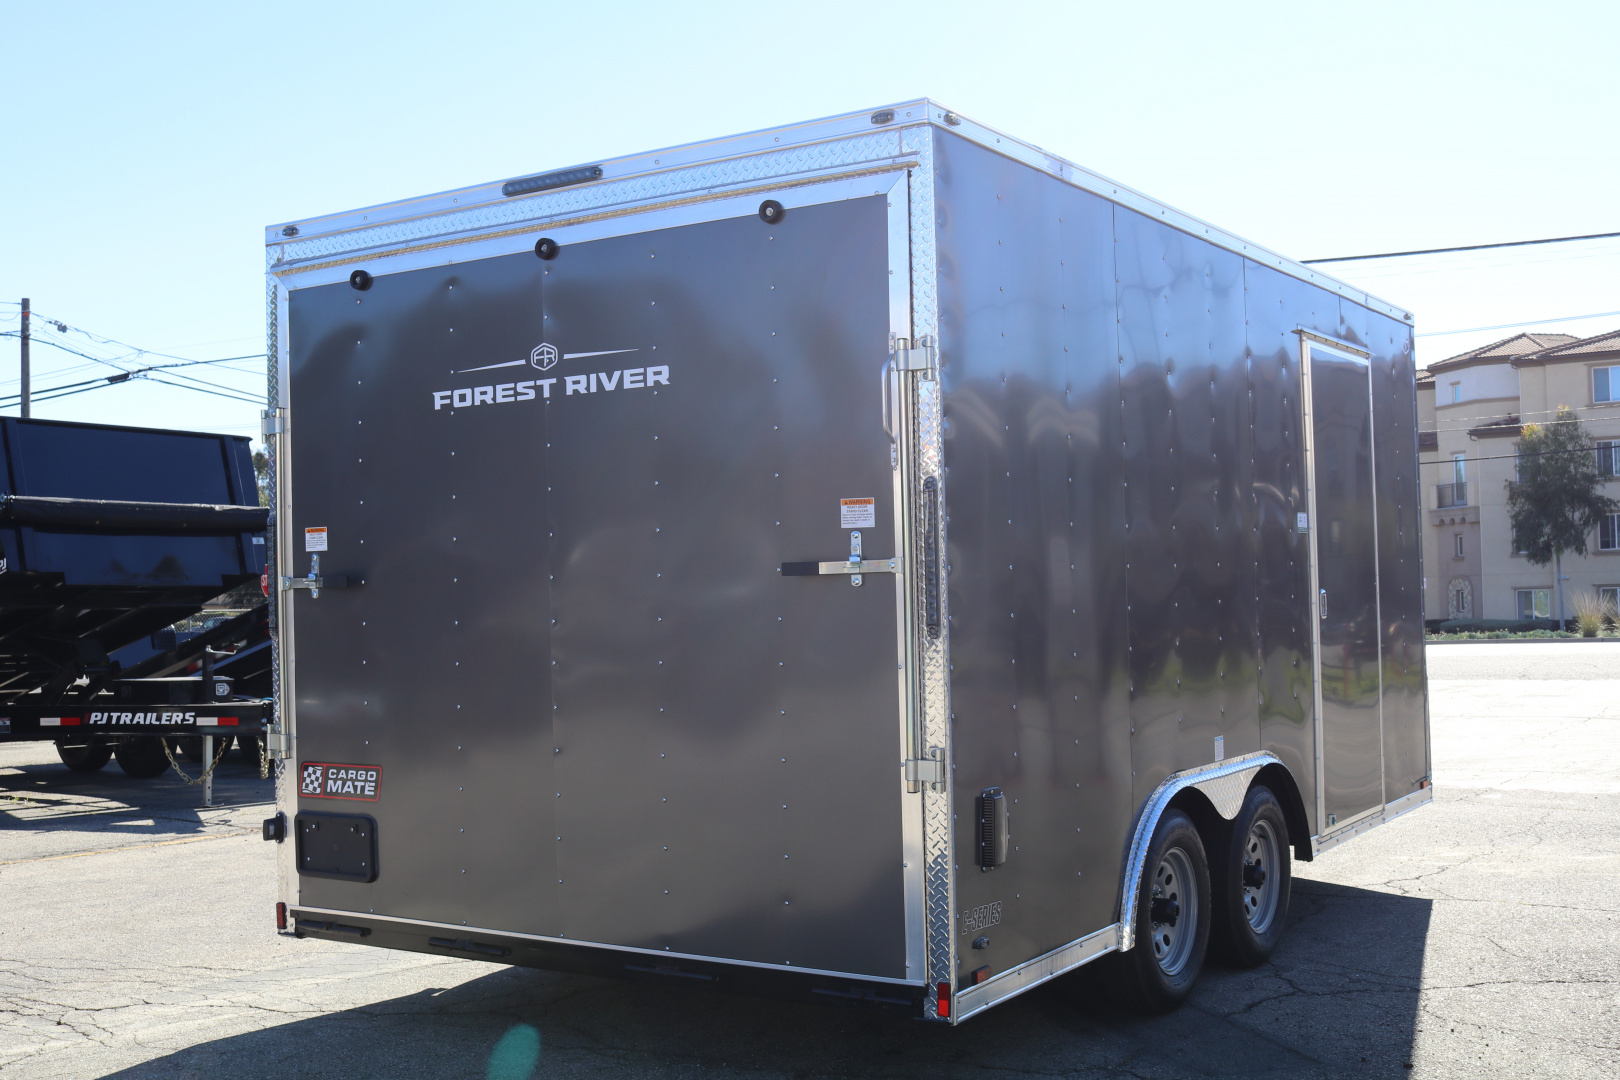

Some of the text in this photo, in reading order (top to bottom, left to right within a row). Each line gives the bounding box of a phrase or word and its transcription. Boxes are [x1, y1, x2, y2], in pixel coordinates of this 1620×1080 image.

[432, 365, 670, 410] FOREST RIVER
[110, 712, 196, 725] TRAILERS
[328, 769, 377, 781] CARGO
[326, 779, 376, 796] MATE
[961, 900, 1002, 936] E-SERIES
